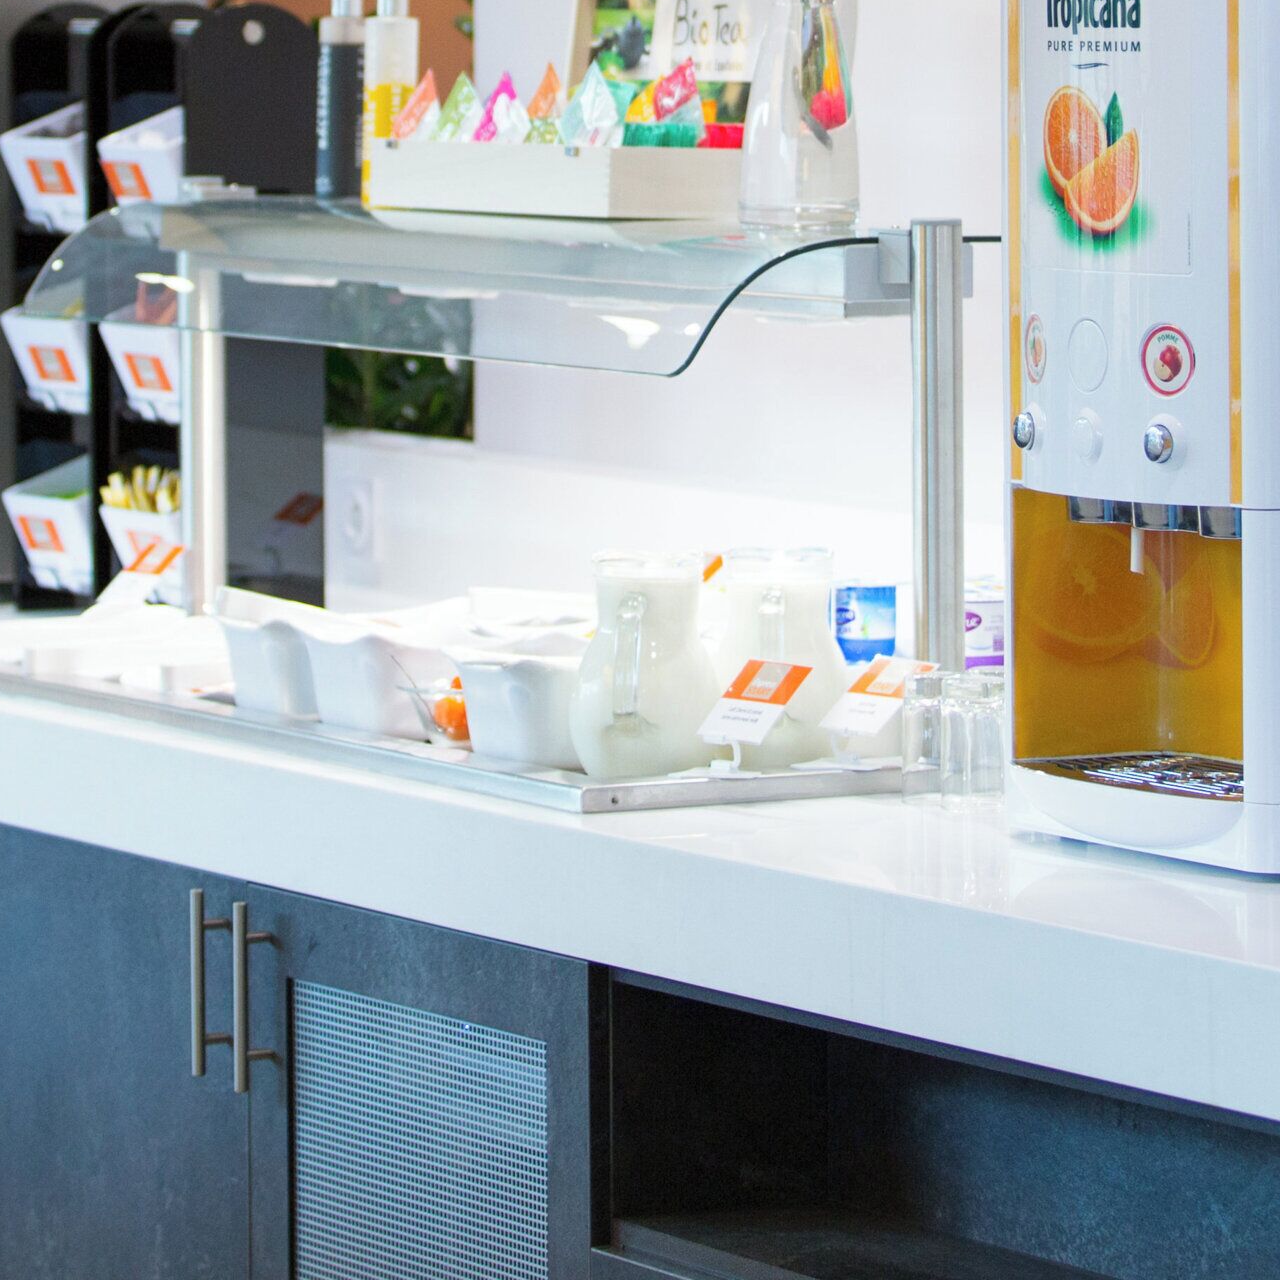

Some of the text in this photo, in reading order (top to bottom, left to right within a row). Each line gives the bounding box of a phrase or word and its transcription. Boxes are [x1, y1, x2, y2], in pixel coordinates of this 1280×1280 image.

[713, 4, 748, 47] Tea
[1047, 40, 1141, 52] PURE PREMIUM
